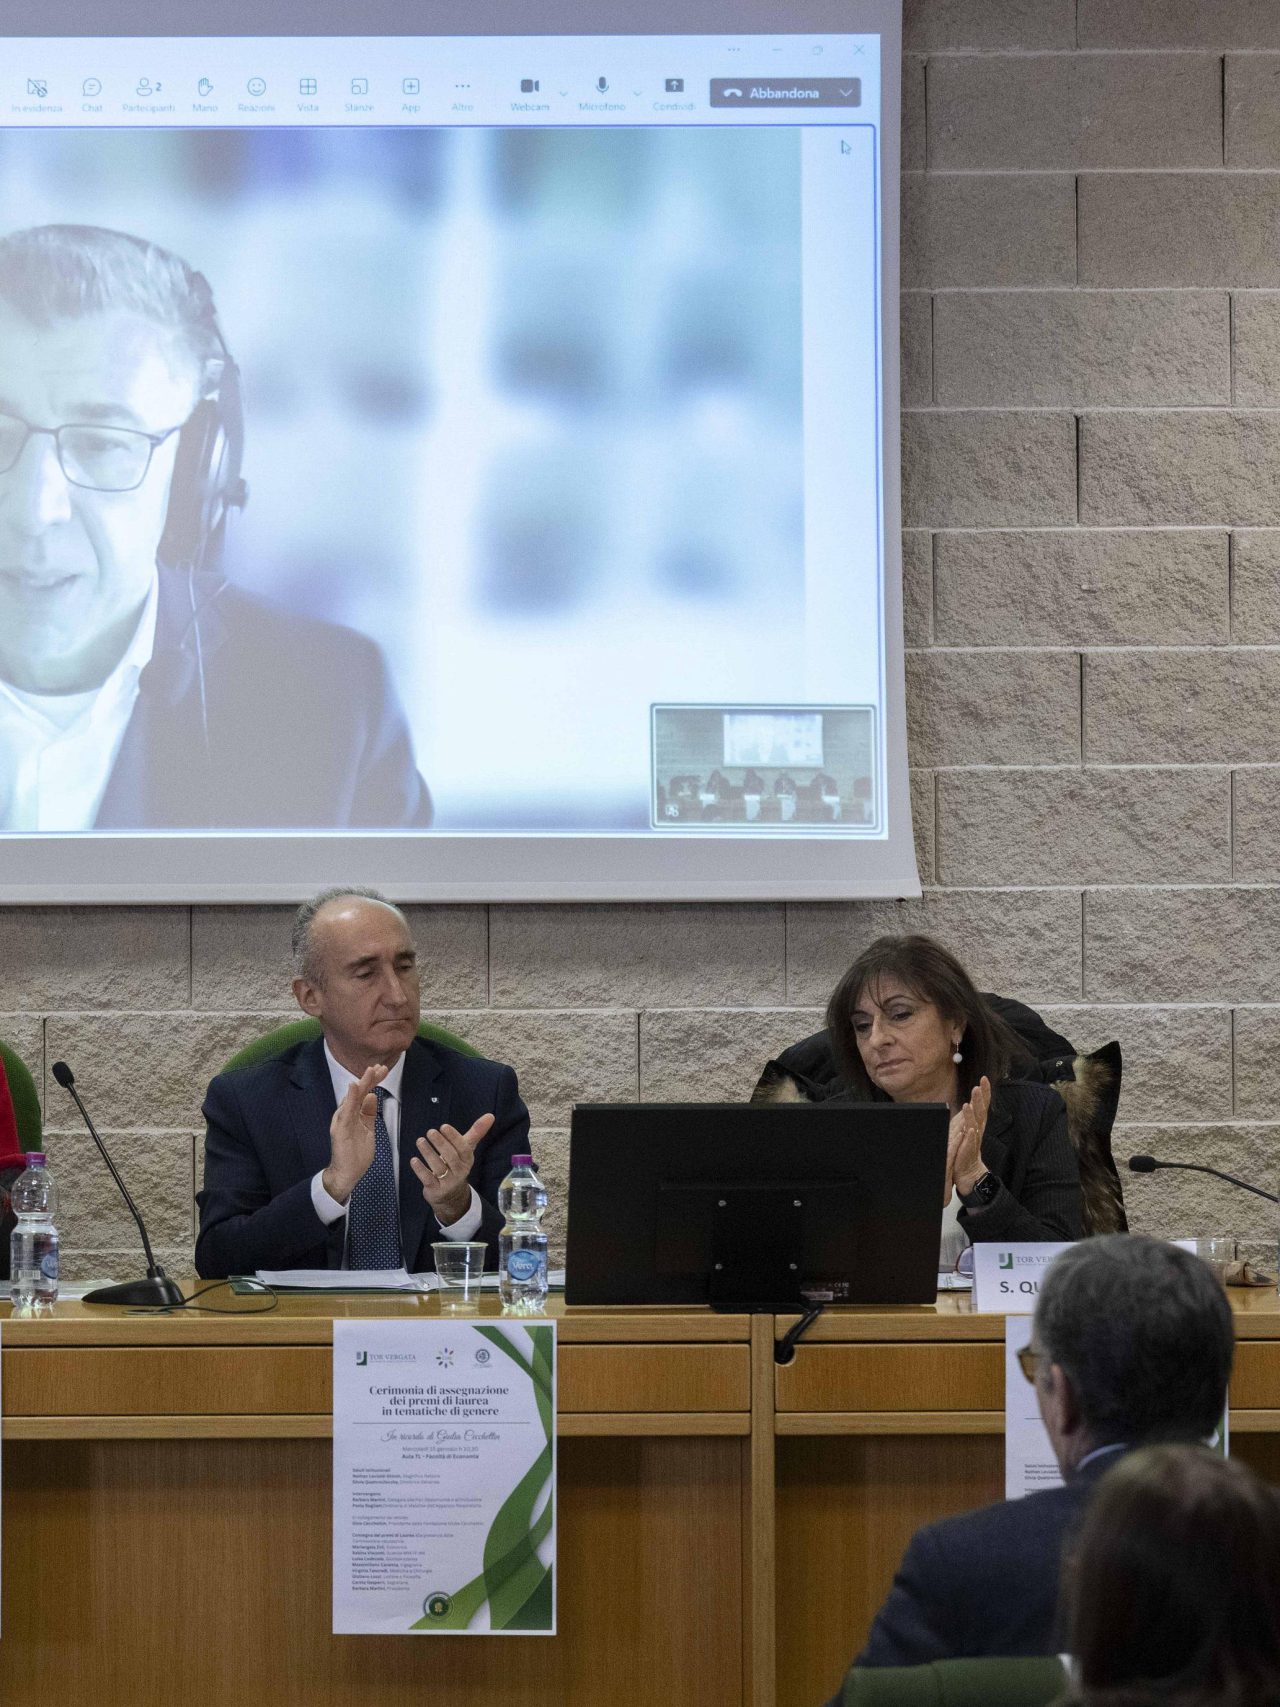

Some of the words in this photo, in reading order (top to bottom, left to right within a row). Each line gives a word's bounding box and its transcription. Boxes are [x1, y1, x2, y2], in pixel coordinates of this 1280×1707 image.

[156, 82, 162, 91] 2
[750, 87, 819, 100] Abbandona
[82, 104, 102, 112] Chat
[511, 103, 550, 112] Webcam
[1000, 1281, 1014, 1293] S.
[370, 1385, 424, 1395] Cerimonia
[427, 1385, 437, 1395] di
[440, 1386, 509, 1396] assegnazione
[390, 1396, 406, 1406] dei
[408, 1396, 440, 1407] premi
[442, 1396, 452, 1406] di
[455, 1396, 488, 1406] laurea
[382, 1406, 392, 1416] in
[395, 1406, 447, 1416] tematiche
[450, 1406, 460, 1416] di
[463, 1408, 499, 1418] genere
[427, 1430, 434, 1440] di
[436, 1430, 461, 1444] Giulia
